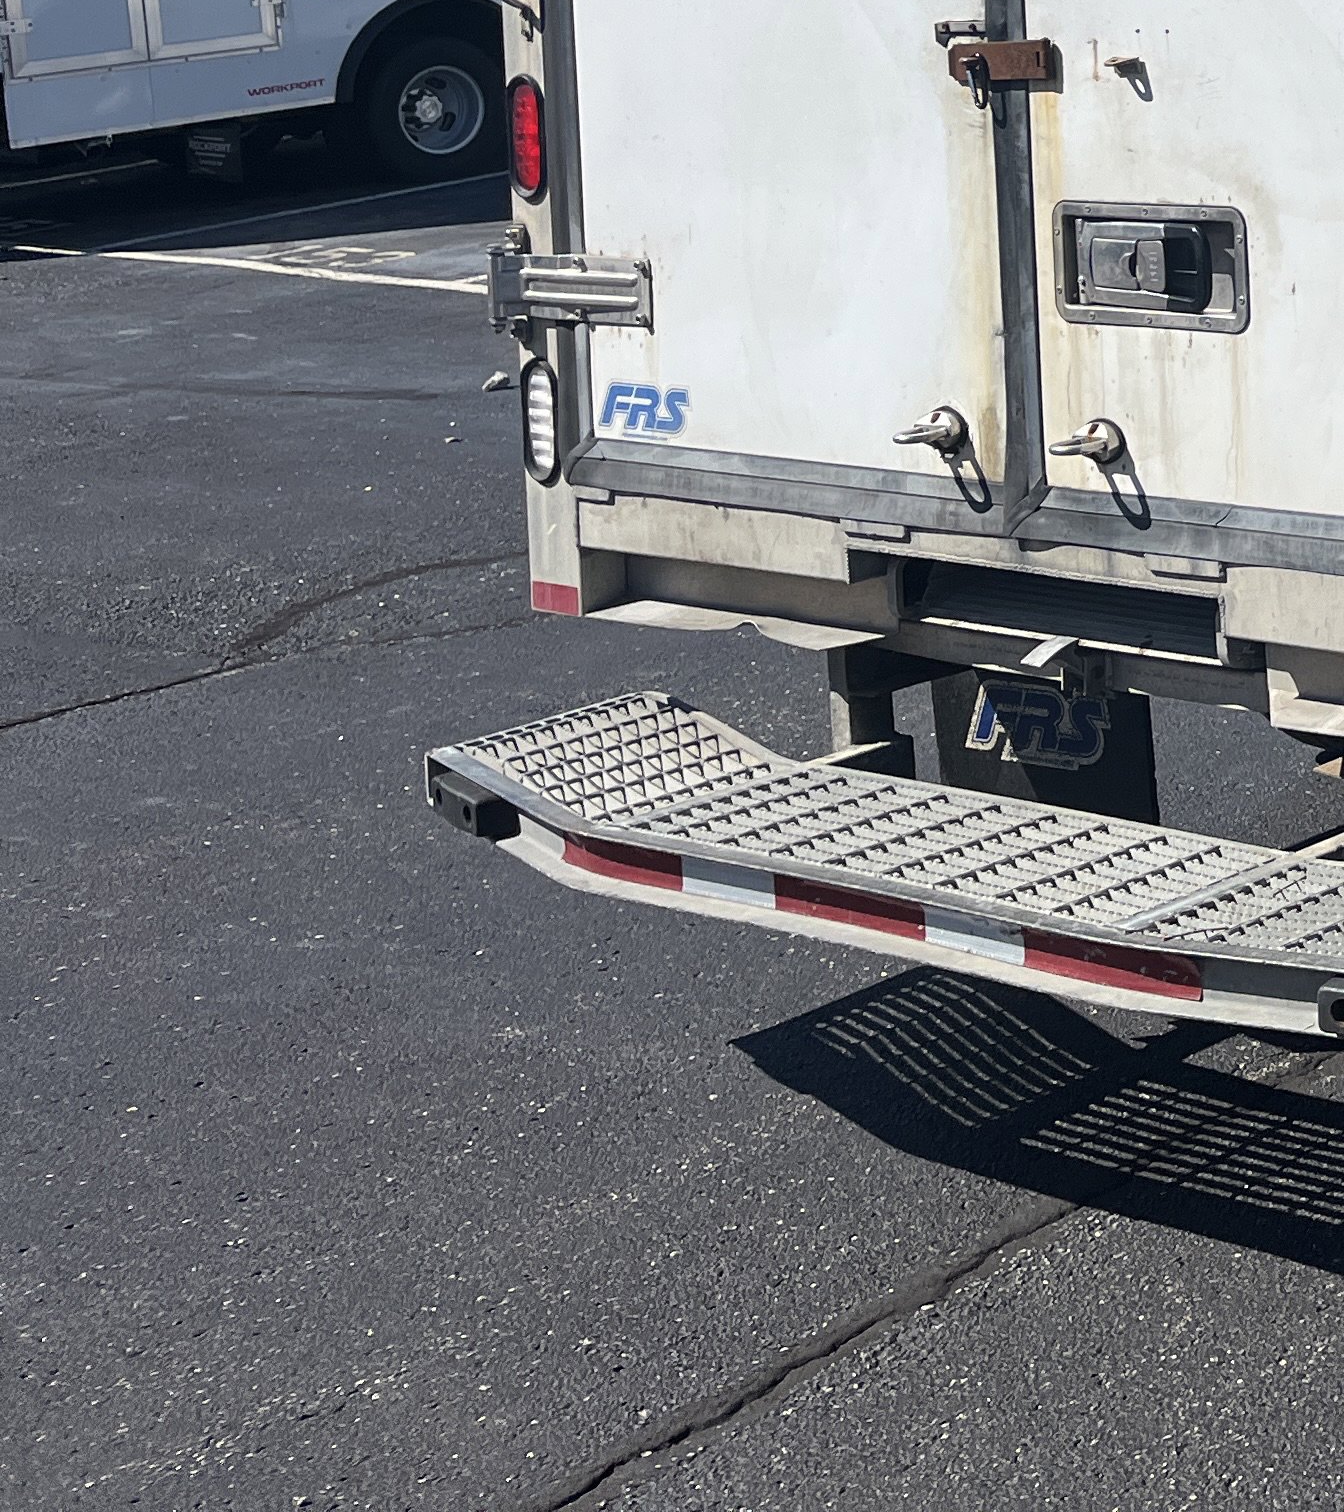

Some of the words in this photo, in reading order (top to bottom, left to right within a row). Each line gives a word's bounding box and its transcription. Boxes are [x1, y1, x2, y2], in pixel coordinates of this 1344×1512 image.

[247, 78, 326, 97] WORKPORT
[598, 381, 690, 434] FRS
[969, 682, 1110, 760] FRS
